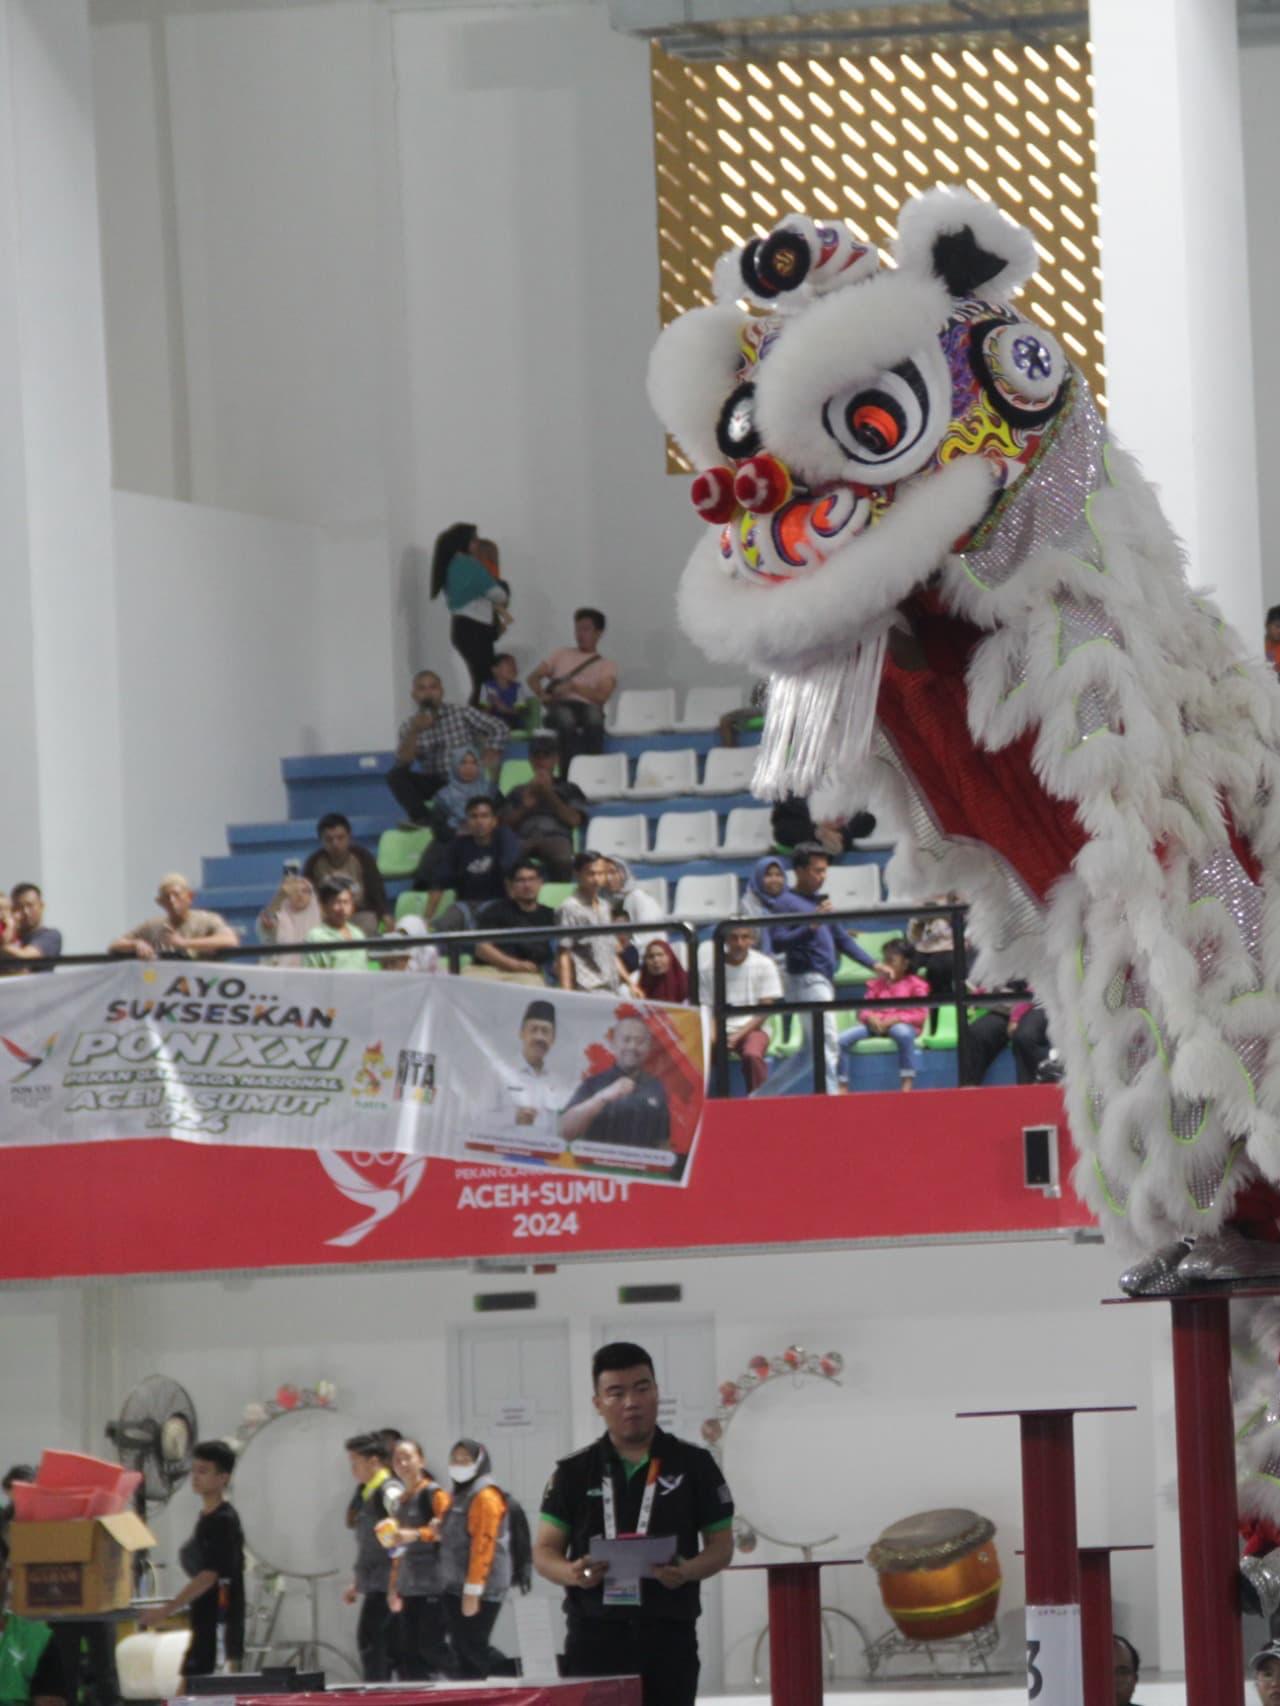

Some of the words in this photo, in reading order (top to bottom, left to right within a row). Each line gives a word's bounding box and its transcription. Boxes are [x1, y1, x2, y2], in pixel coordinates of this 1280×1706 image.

[164, 976, 279, 1000] AYO...
[105, 999, 337, 1028] SUKSESKAN
[68, 1031, 219, 1067] PON
[218, 1034, 349, 1071] XXI
[457, 1180, 631, 1210] ACEH-SUMUT
[512, 1212, 579, 1238] 2024
